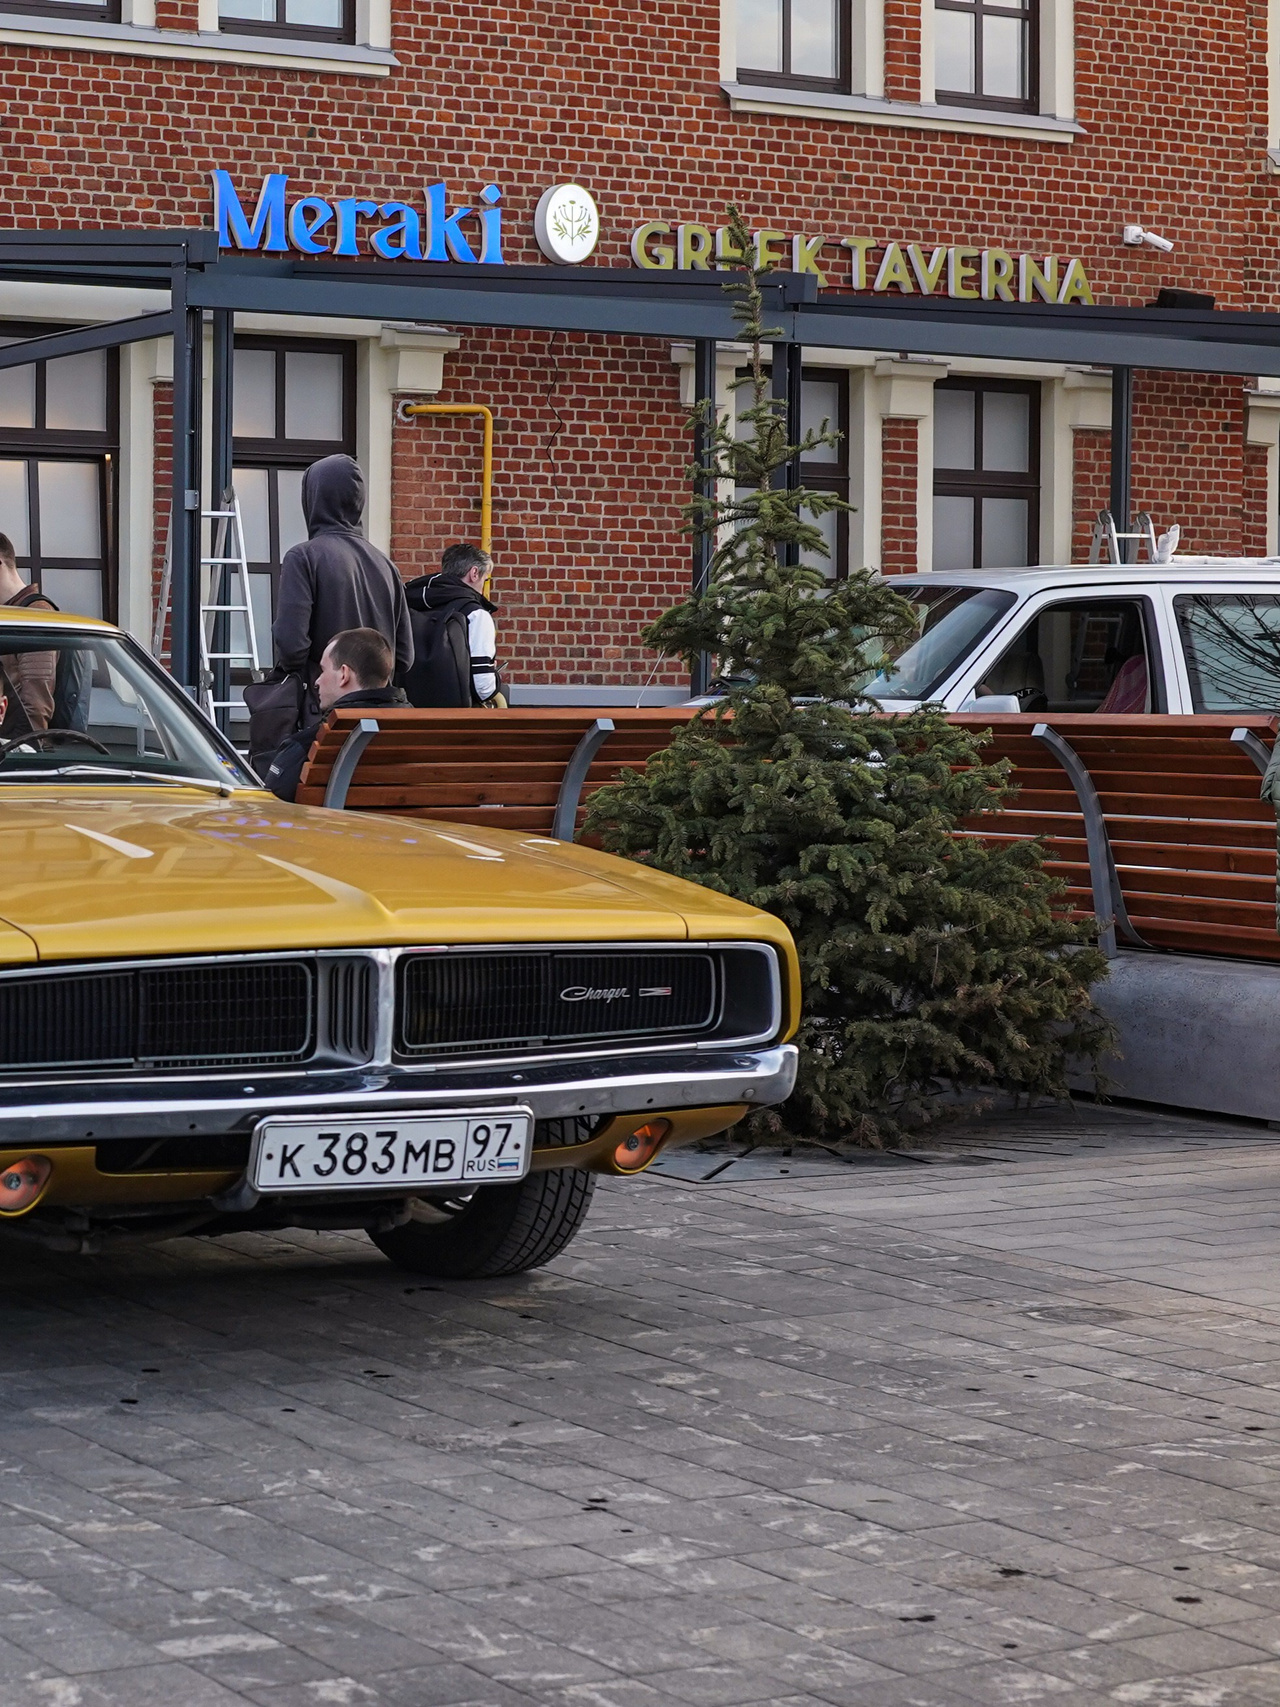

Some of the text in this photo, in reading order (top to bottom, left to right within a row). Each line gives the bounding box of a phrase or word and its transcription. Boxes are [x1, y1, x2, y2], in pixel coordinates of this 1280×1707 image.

[211, 169, 504, 265] Meraki
[840, 238, 1095, 305] TAVERNA
[560, 986, 631, 1004] Charger
[472, 1123, 513, 1158] 97
[466, 1158, 496, 1173] RUS
